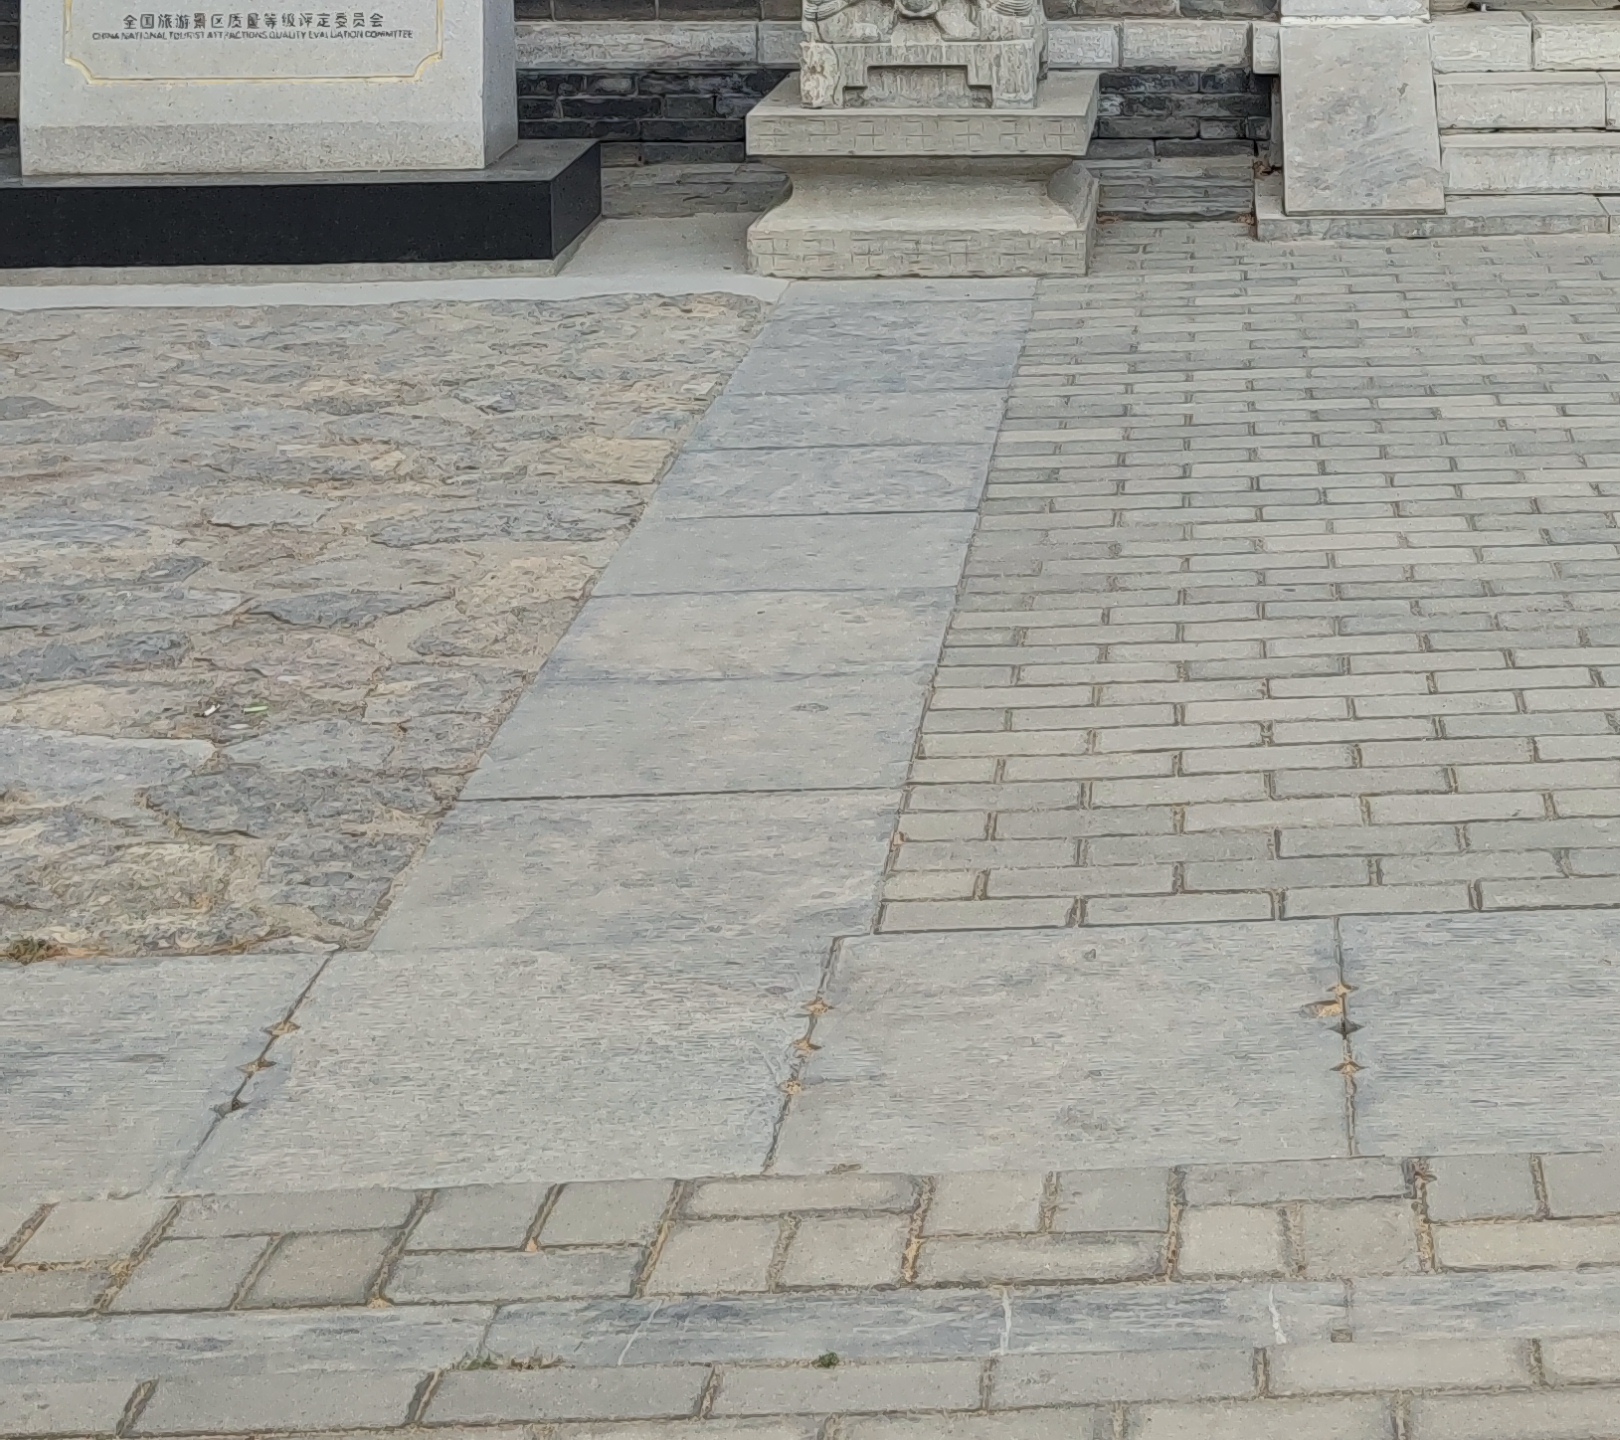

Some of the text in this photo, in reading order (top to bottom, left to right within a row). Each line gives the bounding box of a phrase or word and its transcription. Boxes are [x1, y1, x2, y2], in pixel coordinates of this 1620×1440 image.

[122, 12, 385, 29] 全国旅游景区质量等级评定委员会
